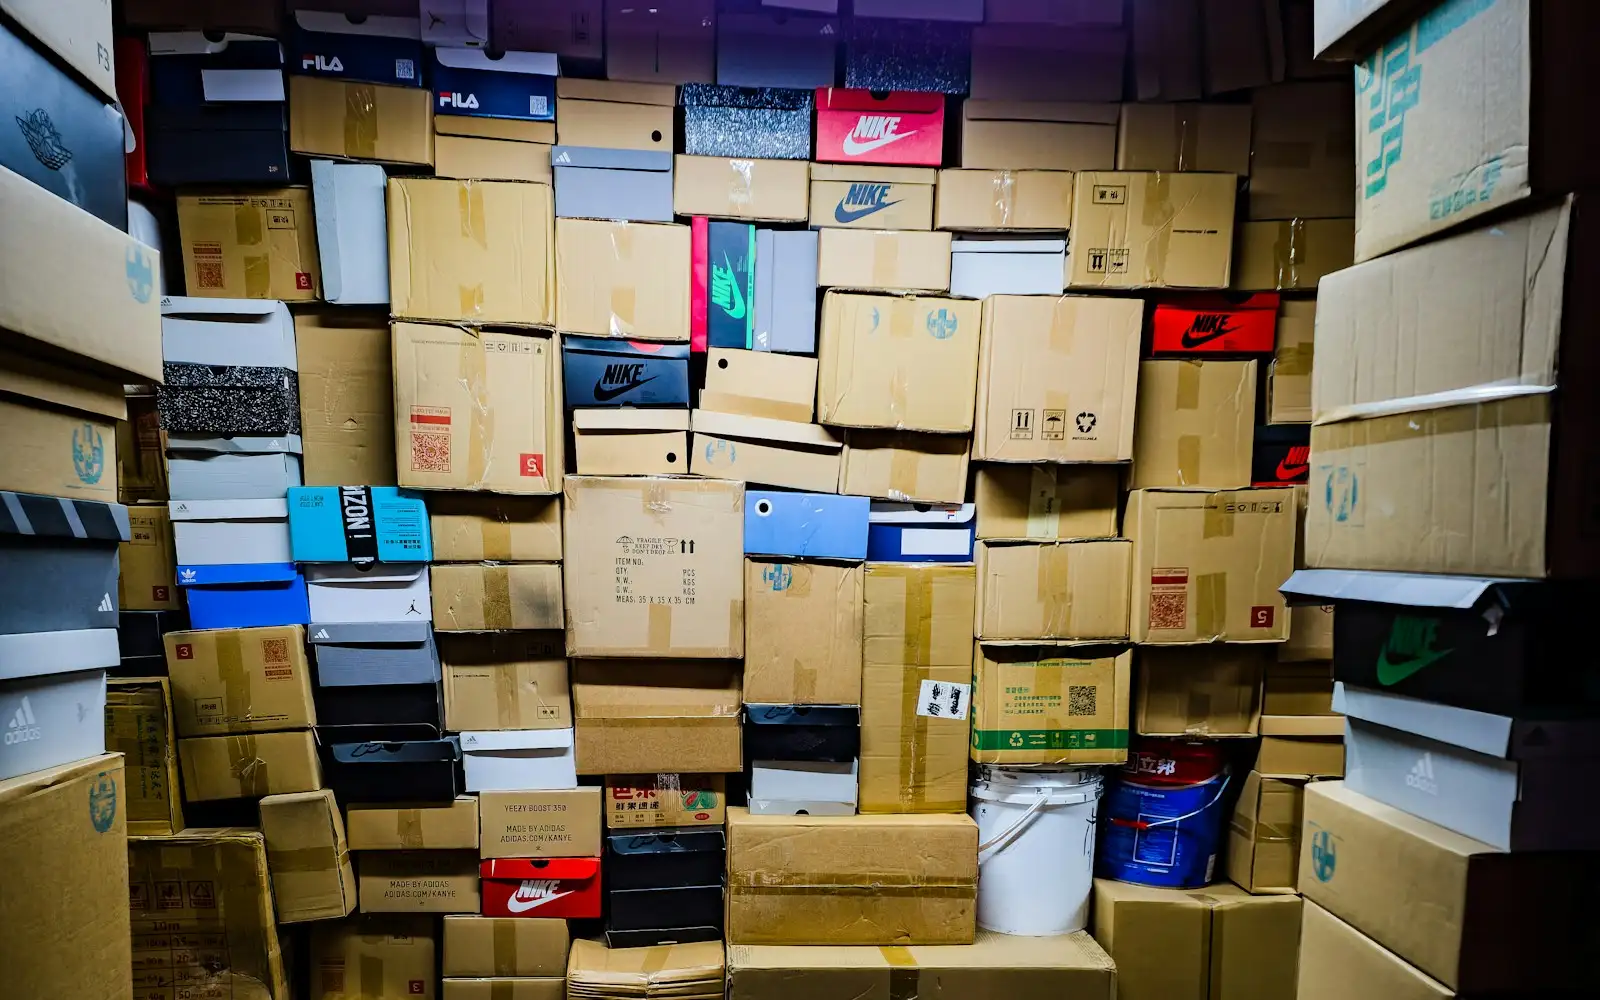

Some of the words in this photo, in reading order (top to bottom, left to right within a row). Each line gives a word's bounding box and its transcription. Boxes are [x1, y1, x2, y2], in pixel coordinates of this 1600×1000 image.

[302, 54, 344, 72] FILA
[439, 91, 480, 109] FILA
[853, 115, 901, 138] NIKE
[845, 183, 891, 206] NIKE
[711, 263, 731, 310] NIKE
[1190, 314, 1233, 333] NIKE
[602, 363, 645, 385] NIKE
[615, 557, 631, 565] ITEM
[682, 569, 696, 577] PCS
[638, 596, 647, 604] 35
[657, 596, 666, 604] 35
[674, 597, 682, 605] 35
[685, 597, 696, 605] CM
[682, 588, 696, 596] KGS
[180, 646, 189, 657] 3
[4, 726, 42, 746] adidas
[1138, 757, 1177, 776] 立邦
[504, 804, 527, 813] YEEZY
[528, 804, 551, 812] BOOST
[552, 804, 567, 812] 350
[506, 825, 527, 833] MADE
[539, 824, 566, 832] ADIDAS
[500, 834, 573, 843] ADIDAS.COM/KANYE
[384, 890, 456, 898] ADIDAS.COM/KANYE
[516, 880, 560, 898] NIKE
